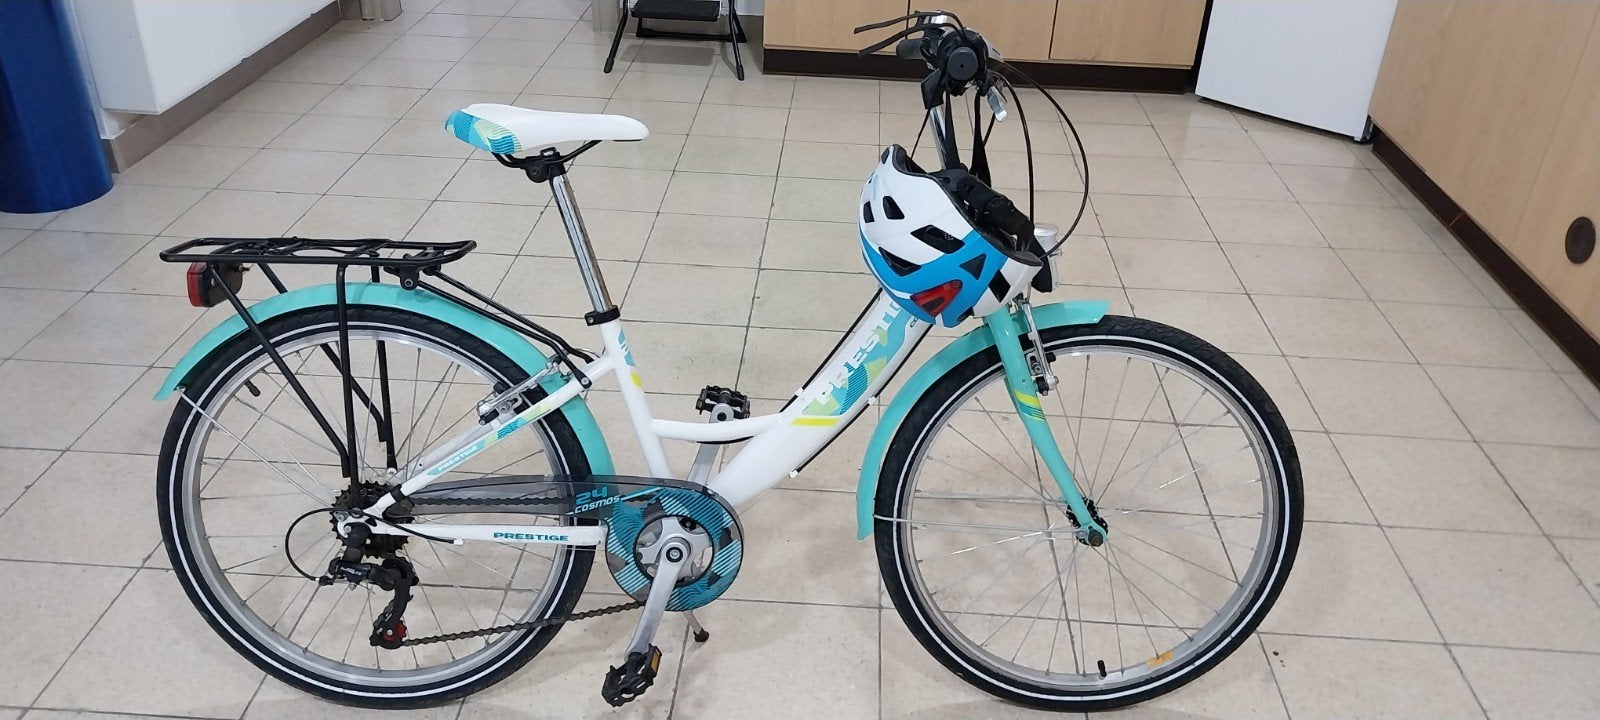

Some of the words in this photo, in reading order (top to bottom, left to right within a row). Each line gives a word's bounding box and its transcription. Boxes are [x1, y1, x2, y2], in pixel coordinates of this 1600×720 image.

[438, 446, 478, 471] PRESTIGE
[575, 486, 608, 504] 24
[493, 532, 569, 542] PRESTIGE
